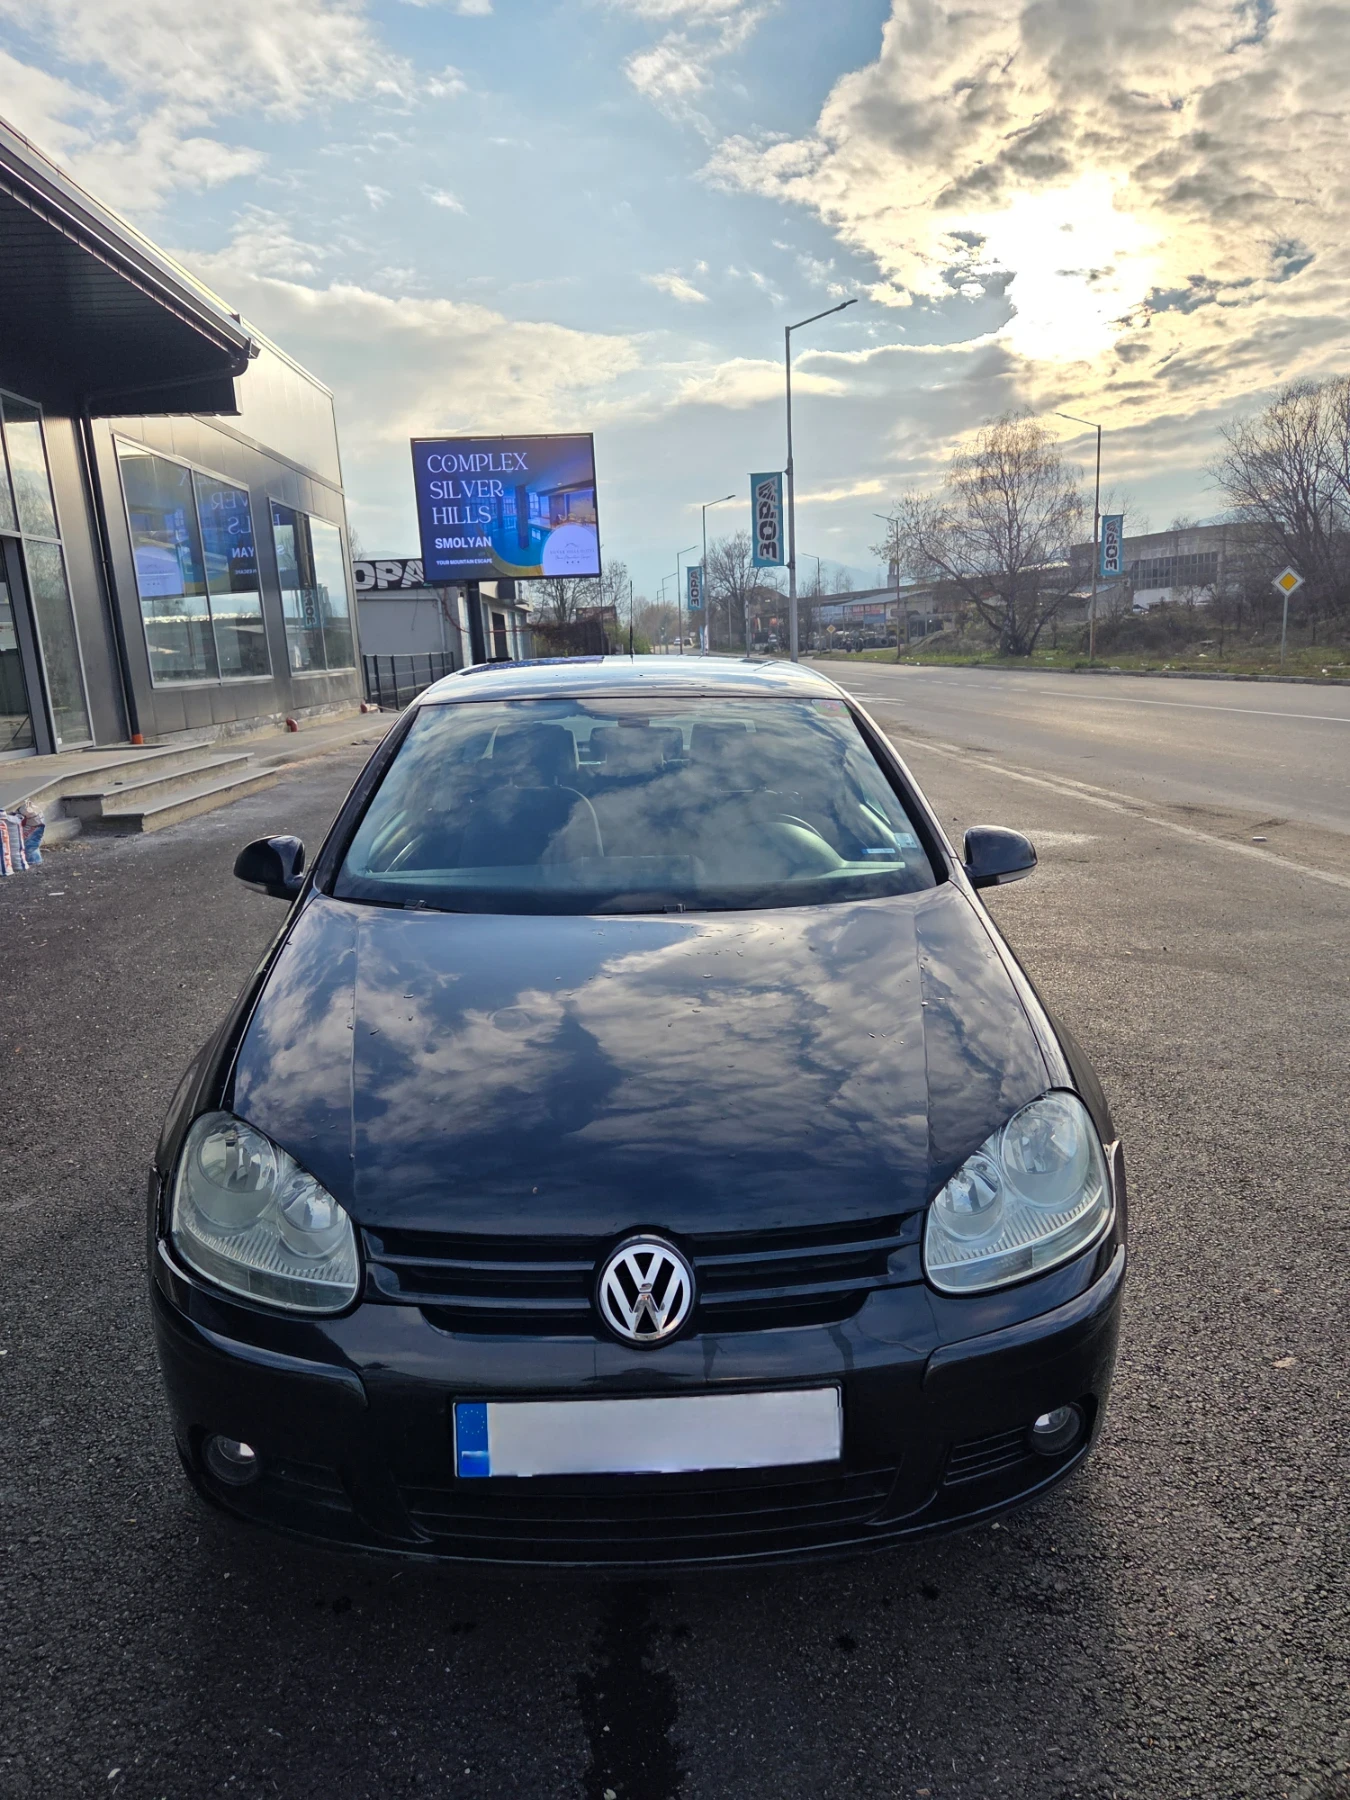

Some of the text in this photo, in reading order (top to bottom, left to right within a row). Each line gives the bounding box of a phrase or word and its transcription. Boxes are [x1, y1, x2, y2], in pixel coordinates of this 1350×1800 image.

[427, 452, 529, 474] COMPLEX
[429, 479, 505, 500] SILVER
[432, 505, 492, 525] HILLS
[434, 536, 492, 549] SMOLYAN
